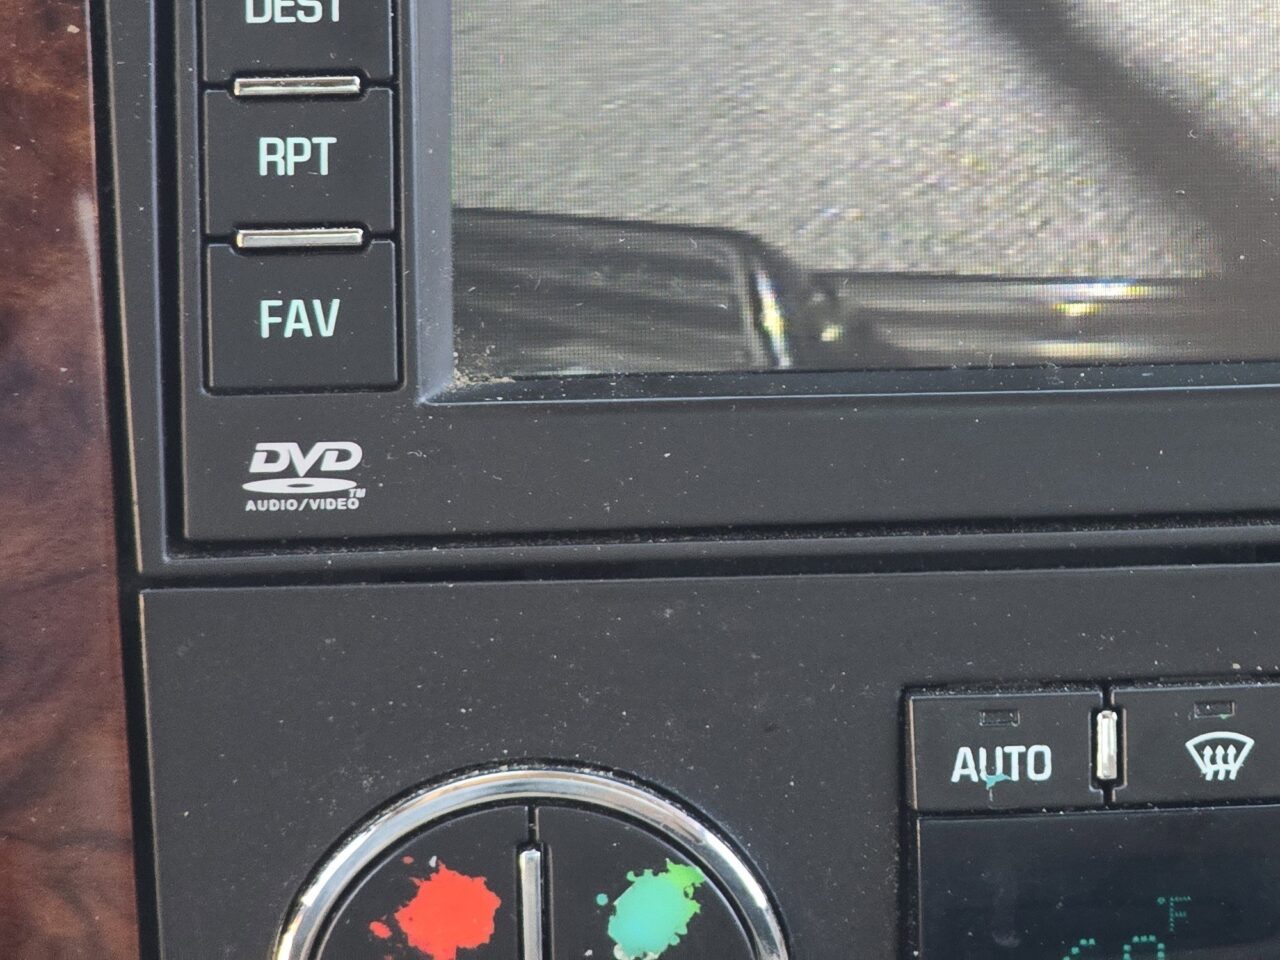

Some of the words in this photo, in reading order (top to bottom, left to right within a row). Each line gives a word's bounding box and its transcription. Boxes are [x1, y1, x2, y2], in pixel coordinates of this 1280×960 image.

[258, 136, 338, 177] RPT
[259, 297, 341, 339] FAV
[248, 441, 363, 478] DVD
[244, 497, 361, 512] AUDIO/VIDEO
[950, 743, 1053, 784] AUTO
